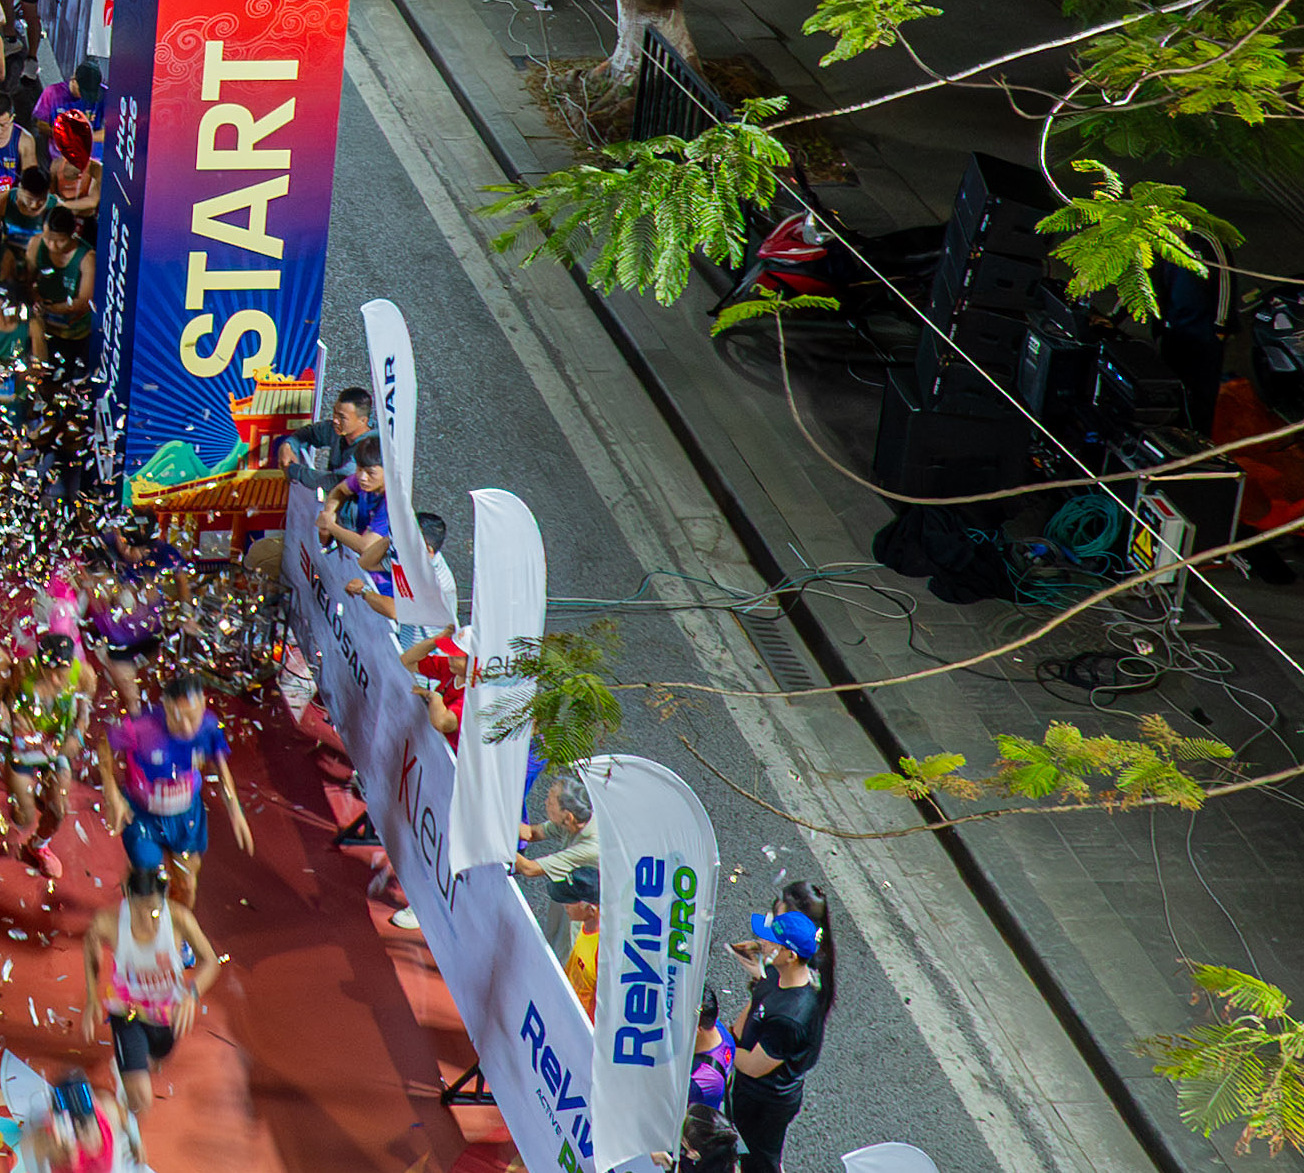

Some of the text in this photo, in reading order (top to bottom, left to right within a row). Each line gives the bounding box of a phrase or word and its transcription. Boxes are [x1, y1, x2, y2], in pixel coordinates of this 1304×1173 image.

[116, 96, 127, 160] Hue
[125, 96, 138, 180] 2026
[179, 41, 299, 379] START
[98, 203, 120, 382] VnExpress
[110, 223, 131, 403] Marathon
[311, 573, 370, 697] VELOSAR
[612, 855, 666, 1068] ReVive
[665, 866, 697, 1021] ACTIVE PRO
[520, 1000, 594, 1159] ReViv
[536, 1088, 562, 1135] ACTIVE
